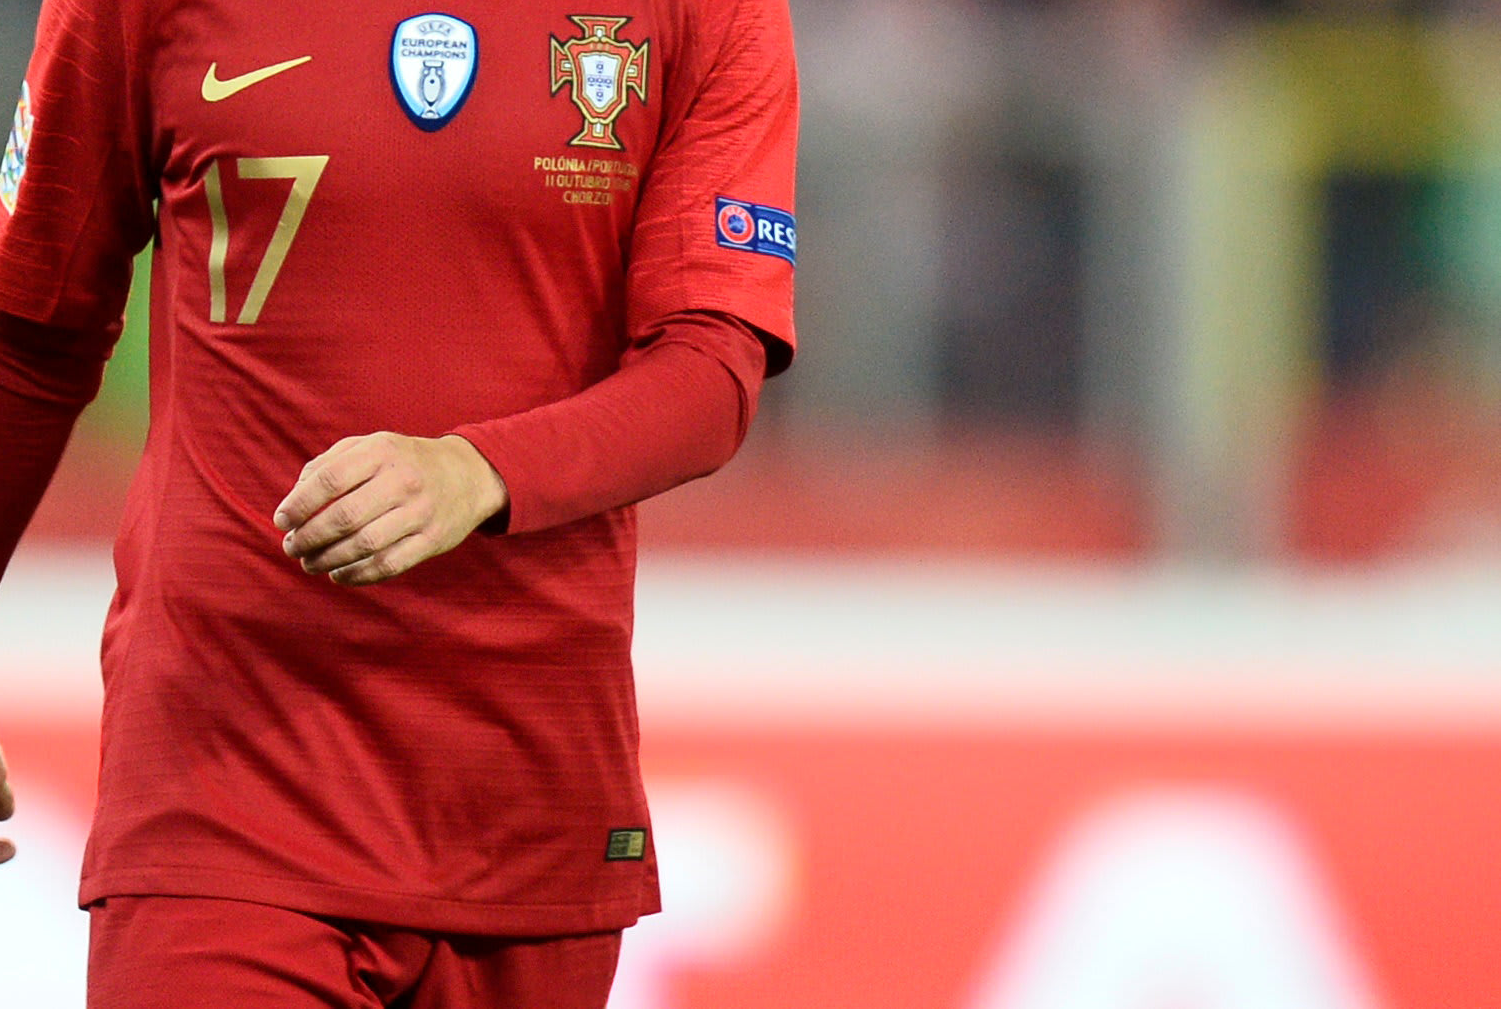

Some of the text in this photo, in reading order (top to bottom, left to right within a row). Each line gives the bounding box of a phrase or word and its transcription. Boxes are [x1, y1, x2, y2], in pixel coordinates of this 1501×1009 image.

[418, 22, 451, 34] UEFA
[402, 38, 467, 48] EUROPEAN
[401, 48, 467, 59] CHAMPIONS
[557, 175, 610, 189] OUTUBRO
[563, 191, 613, 205] CHORZO
[203, 155, 330, 324] 17
